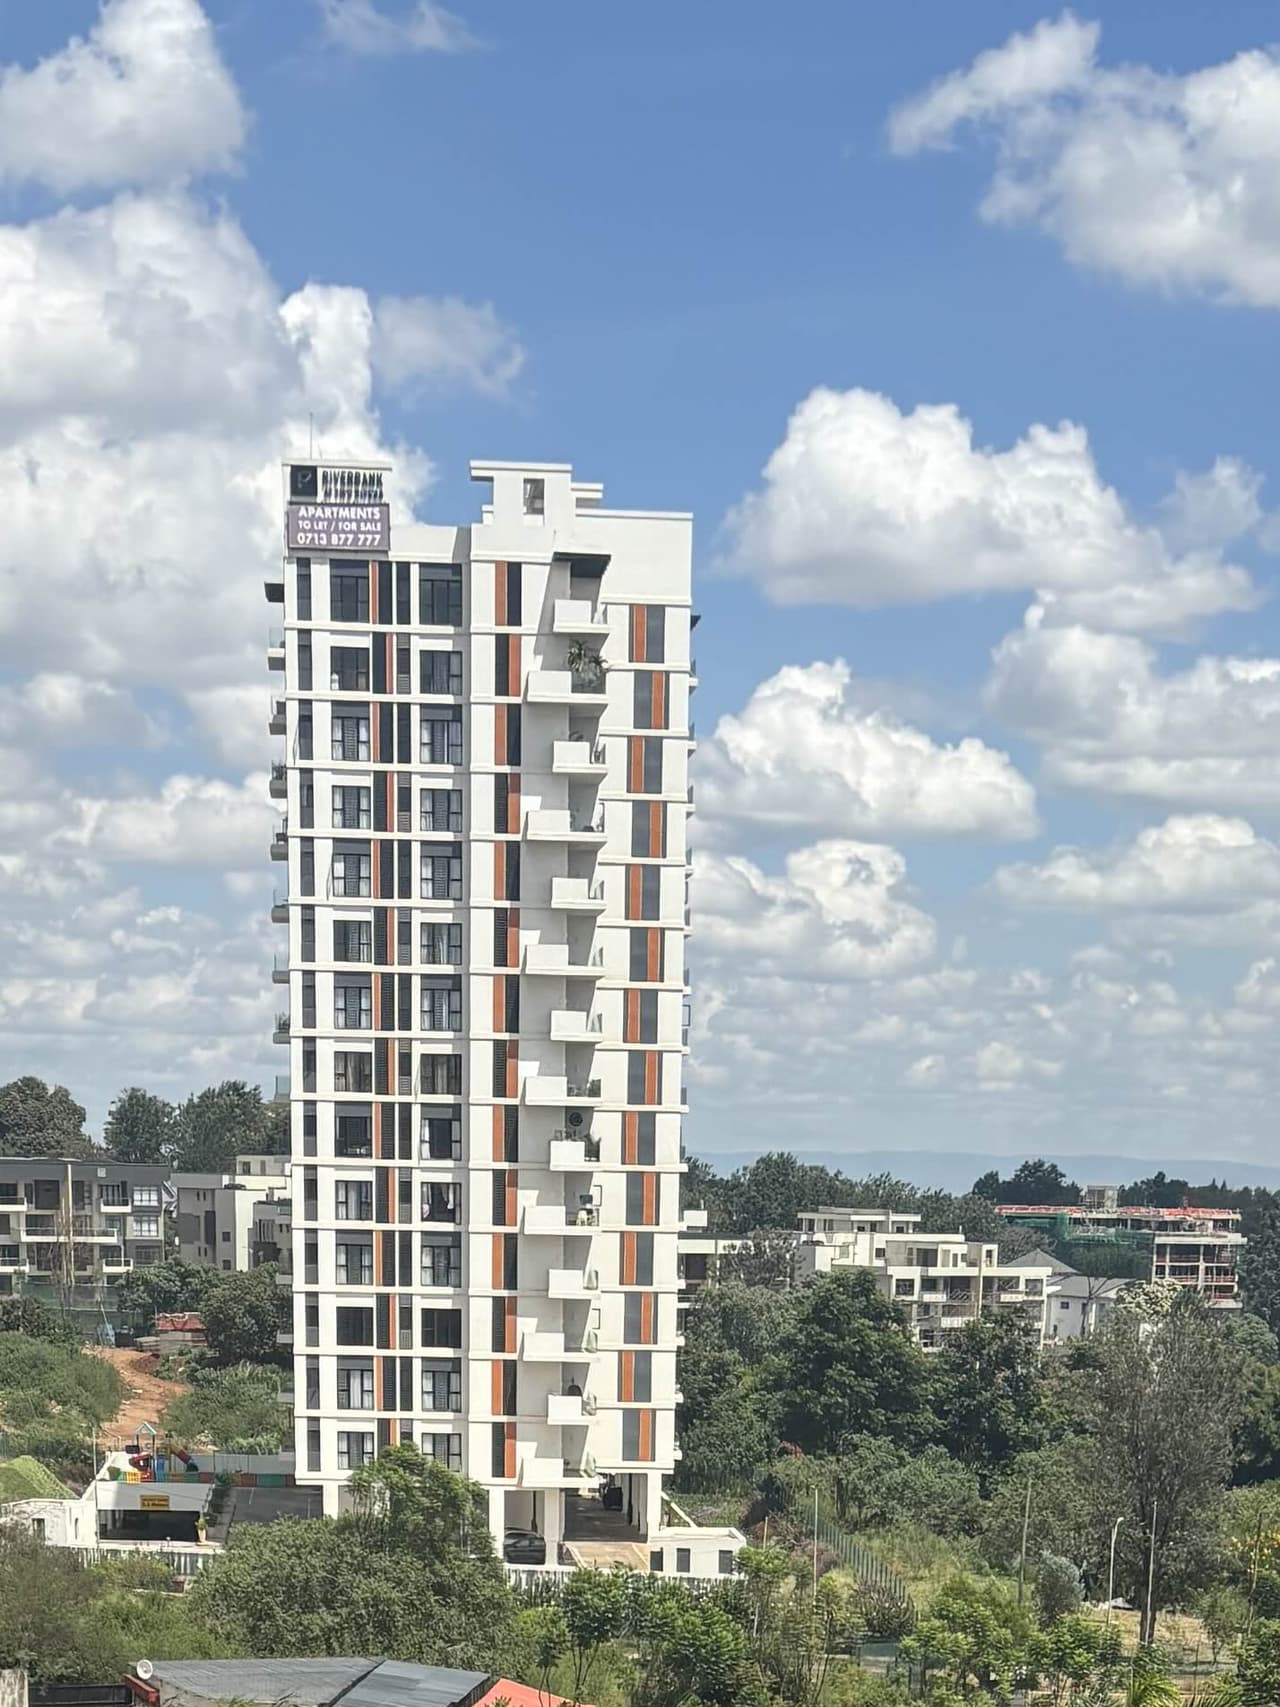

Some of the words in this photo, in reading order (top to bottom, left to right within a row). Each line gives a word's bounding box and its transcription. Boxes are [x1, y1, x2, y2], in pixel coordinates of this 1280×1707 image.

[321, 470, 383, 488] RIVERBANK
[298, 506, 381, 520] APARTMENTS
[298, 520, 311, 530] TO
[314, 521, 328, 531] LET
[338, 521, 357, 531] FOR
[360, 522, 382, 532] SALE
[297, 533, 327, 545] 0713
[331, 534, 354, 545] 877
[357, 534, 381, 546] 777
